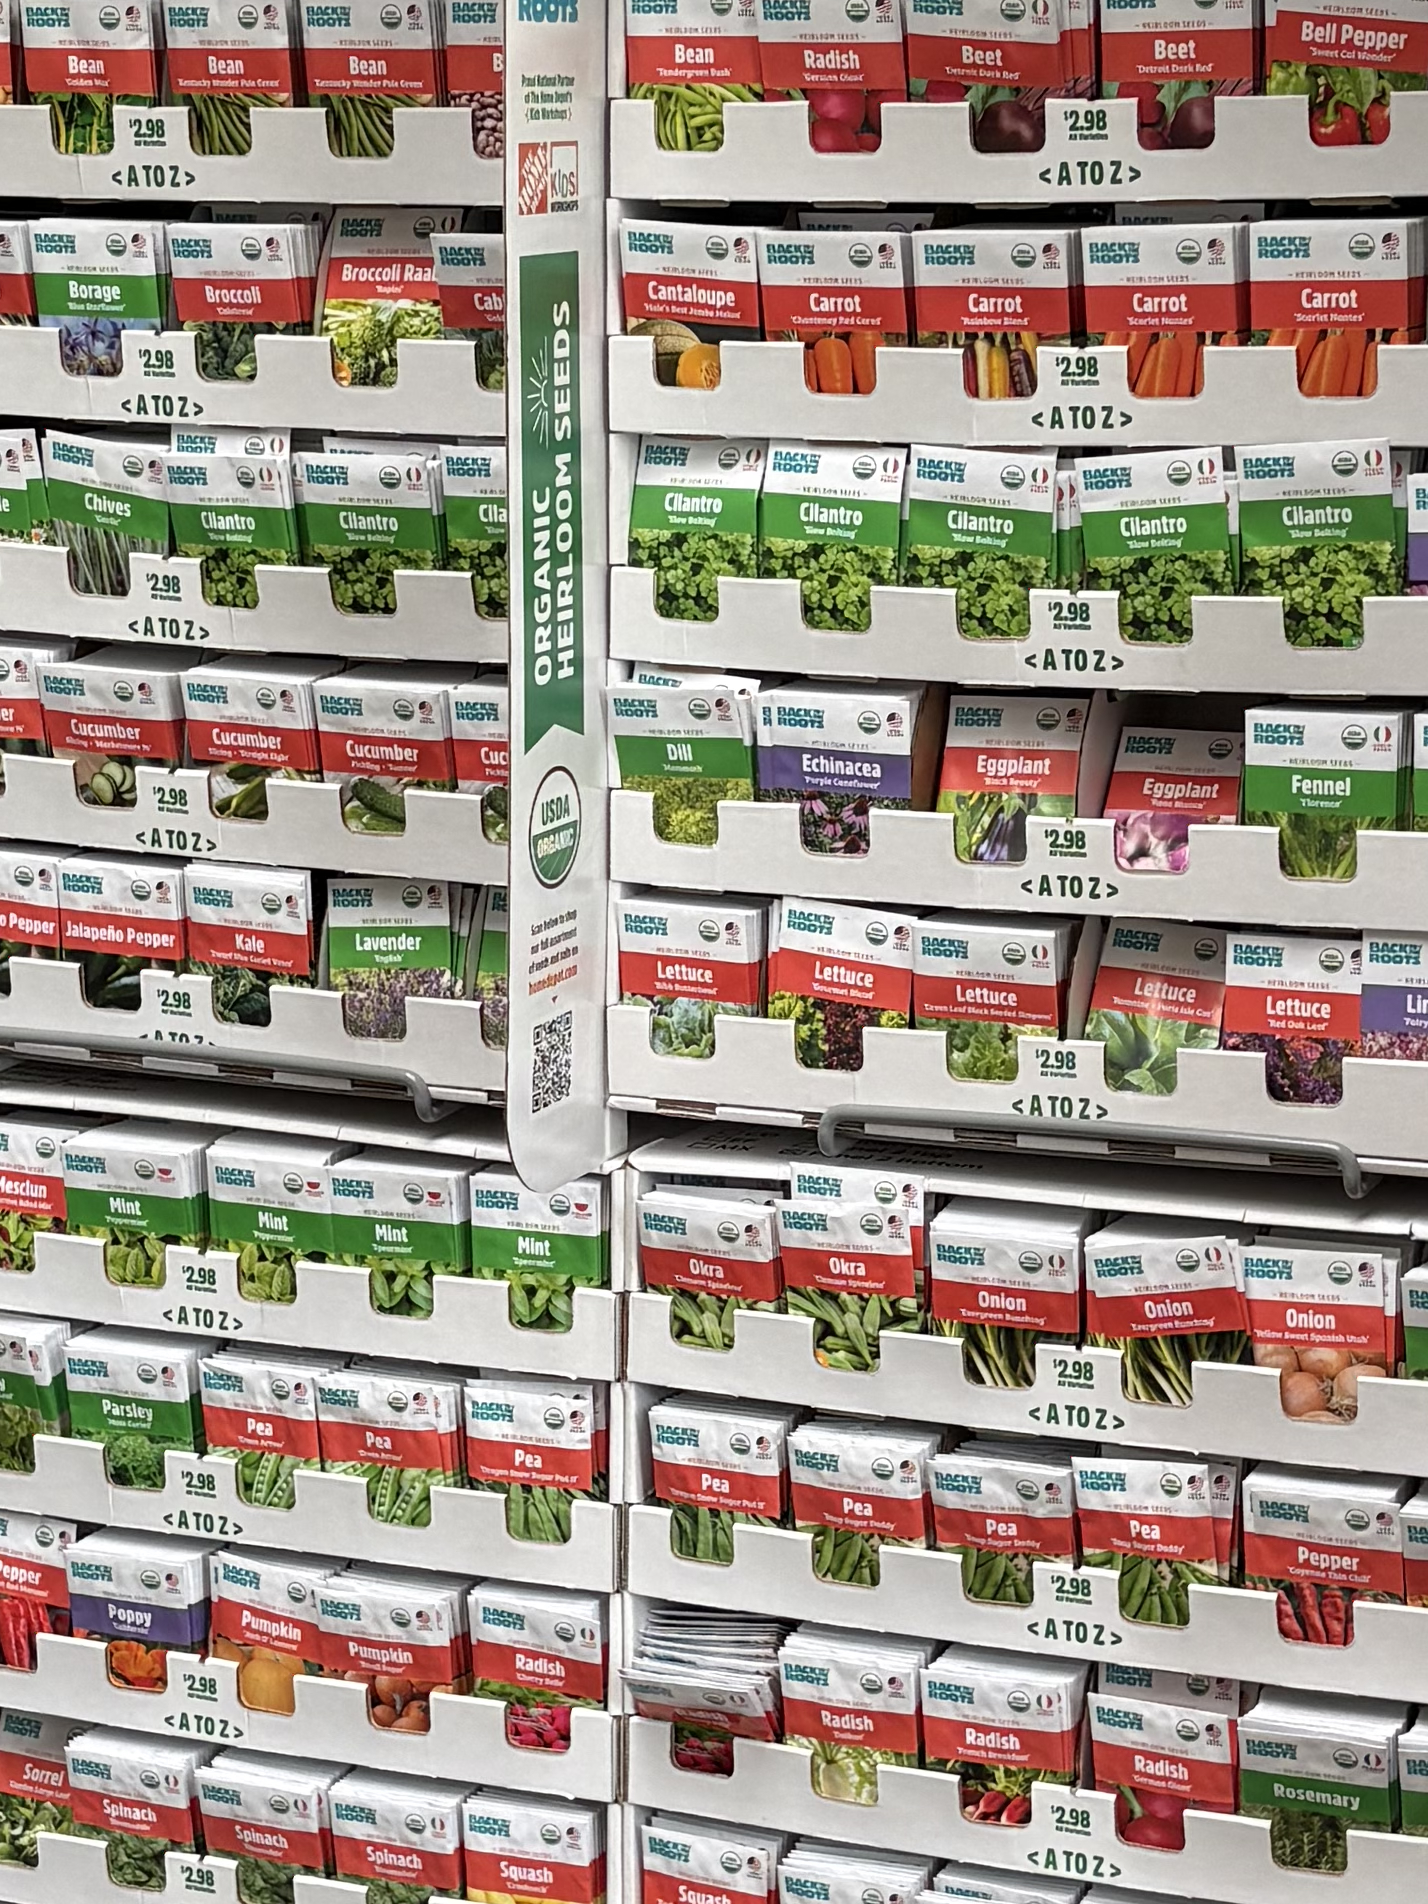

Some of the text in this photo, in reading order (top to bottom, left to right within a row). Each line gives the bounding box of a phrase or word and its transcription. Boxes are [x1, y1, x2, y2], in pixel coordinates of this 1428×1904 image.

[1301, 21, 1408, 50] Bell Pepper
[804, 50, 859, 69] Radish
[1155, 40, 1195, 59] Beet
[551, 169, 576, 198] KIDS
[69, 281, 120, 302] Borage
[205, 286, 261, 303] Broccoli
[644, 281, 735, 313] Cantaloupe
[969, 294, 1022, 312] Carrot
[554, 299, 575, 679] HEIRLOOM SEEDS
[85, 493, 130, 519] Chives
[340, 512, 398, 531] Cilantro
[533, 486, 553, 687] ORGANIC
[667, 744, 692, 761] Dill
[802, 754, 881, 781] Echinacea
[977, 755, 1050, 785] Eggplant
[1292, 775, 1350, 796] Fennel
[9, 913, 55, 934] Pepper
[235, 934, 264, 953] Kale
[356, 933, 421, 950] Lavender
[656, 961, 712, 985] Lettuce
[518, 1236, 550, 1256] Mint
[690, 1259, 724, 1278] Okra
[977, 1291, 1026, 1316] Onion
[515, 1449, 542, 1468] Pea
[108, 1604, 151, 1629] Poppy
[242, 1608, 302, 1642] Pumpkin
[516, 1654, 565, 1678] Radish
[23, 1764, 64, 1786] Sorrel
[1274, 1783, 1360, 1810] Rosemary
[102, 1797, 158, 1824] Spinach
